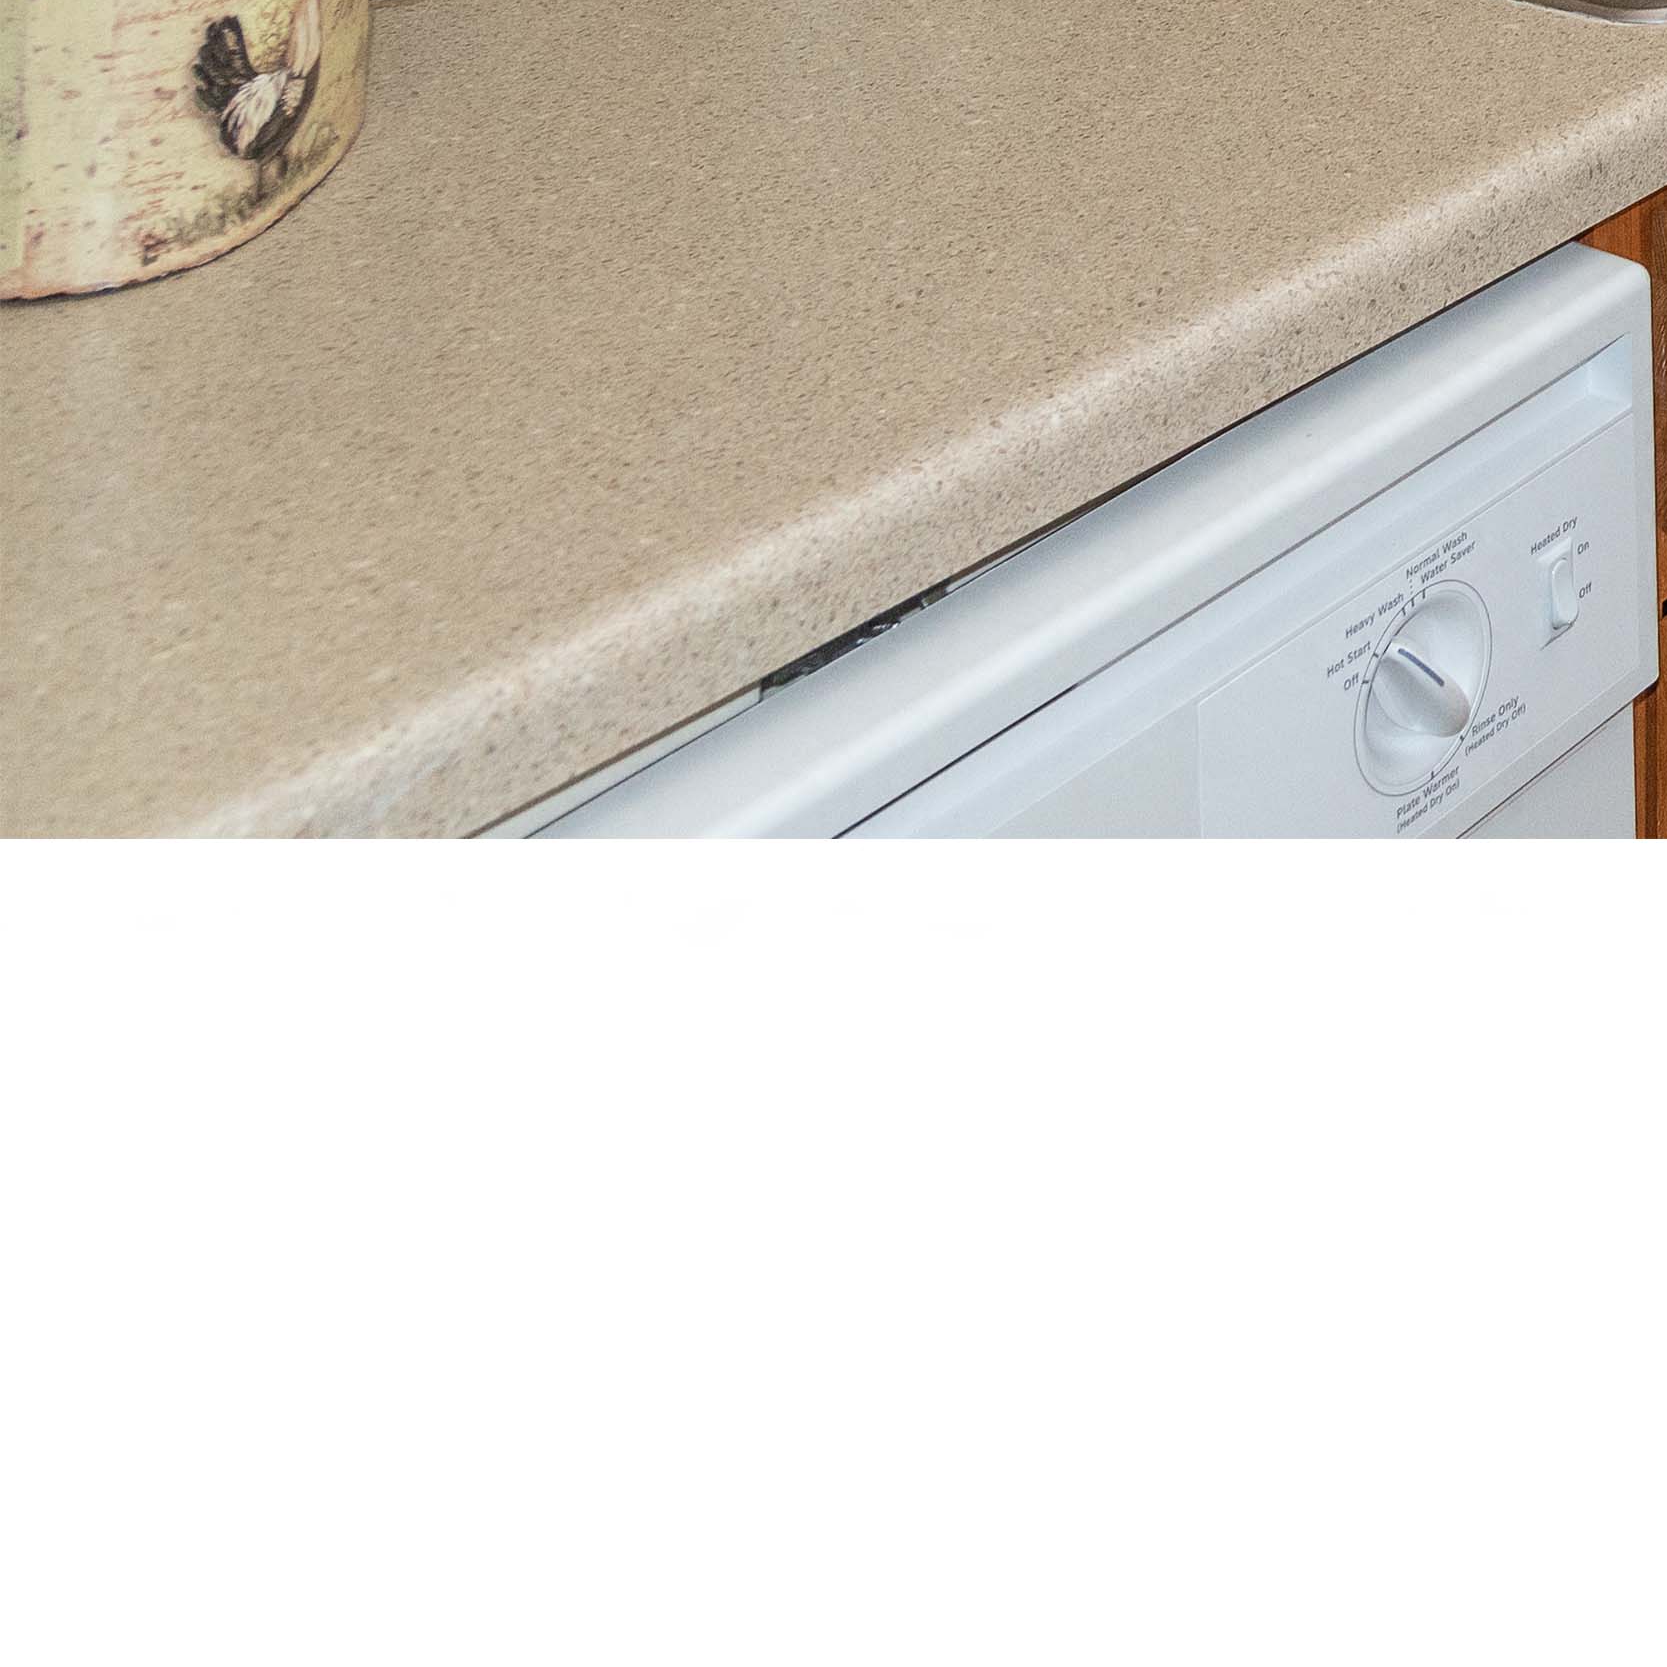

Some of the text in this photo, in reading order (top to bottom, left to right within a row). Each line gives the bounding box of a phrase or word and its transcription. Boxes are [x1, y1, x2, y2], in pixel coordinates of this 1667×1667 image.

[1530, 516, 1578, 555] Heated Dry
[1577, 541, 1590, 554] On
[1406, 531, 1468, 579] Normal Wash
[1420, 541, 1476, 584] Water Saver
[1579, 581, 1592, 598] Off
[1345, 592, 1404, 639] Heavy Wash
[1326, 641, 1371, 678] Hot Start
[1343, 672, 1359, 691] Off
[1471, 695, 1519, 736] Rinse Only
[1496, 717, 1510, 733] Dry
[1396, 766, 1459, 818] Plate Warmer
[1430, 792, 1443, 809] Dry
